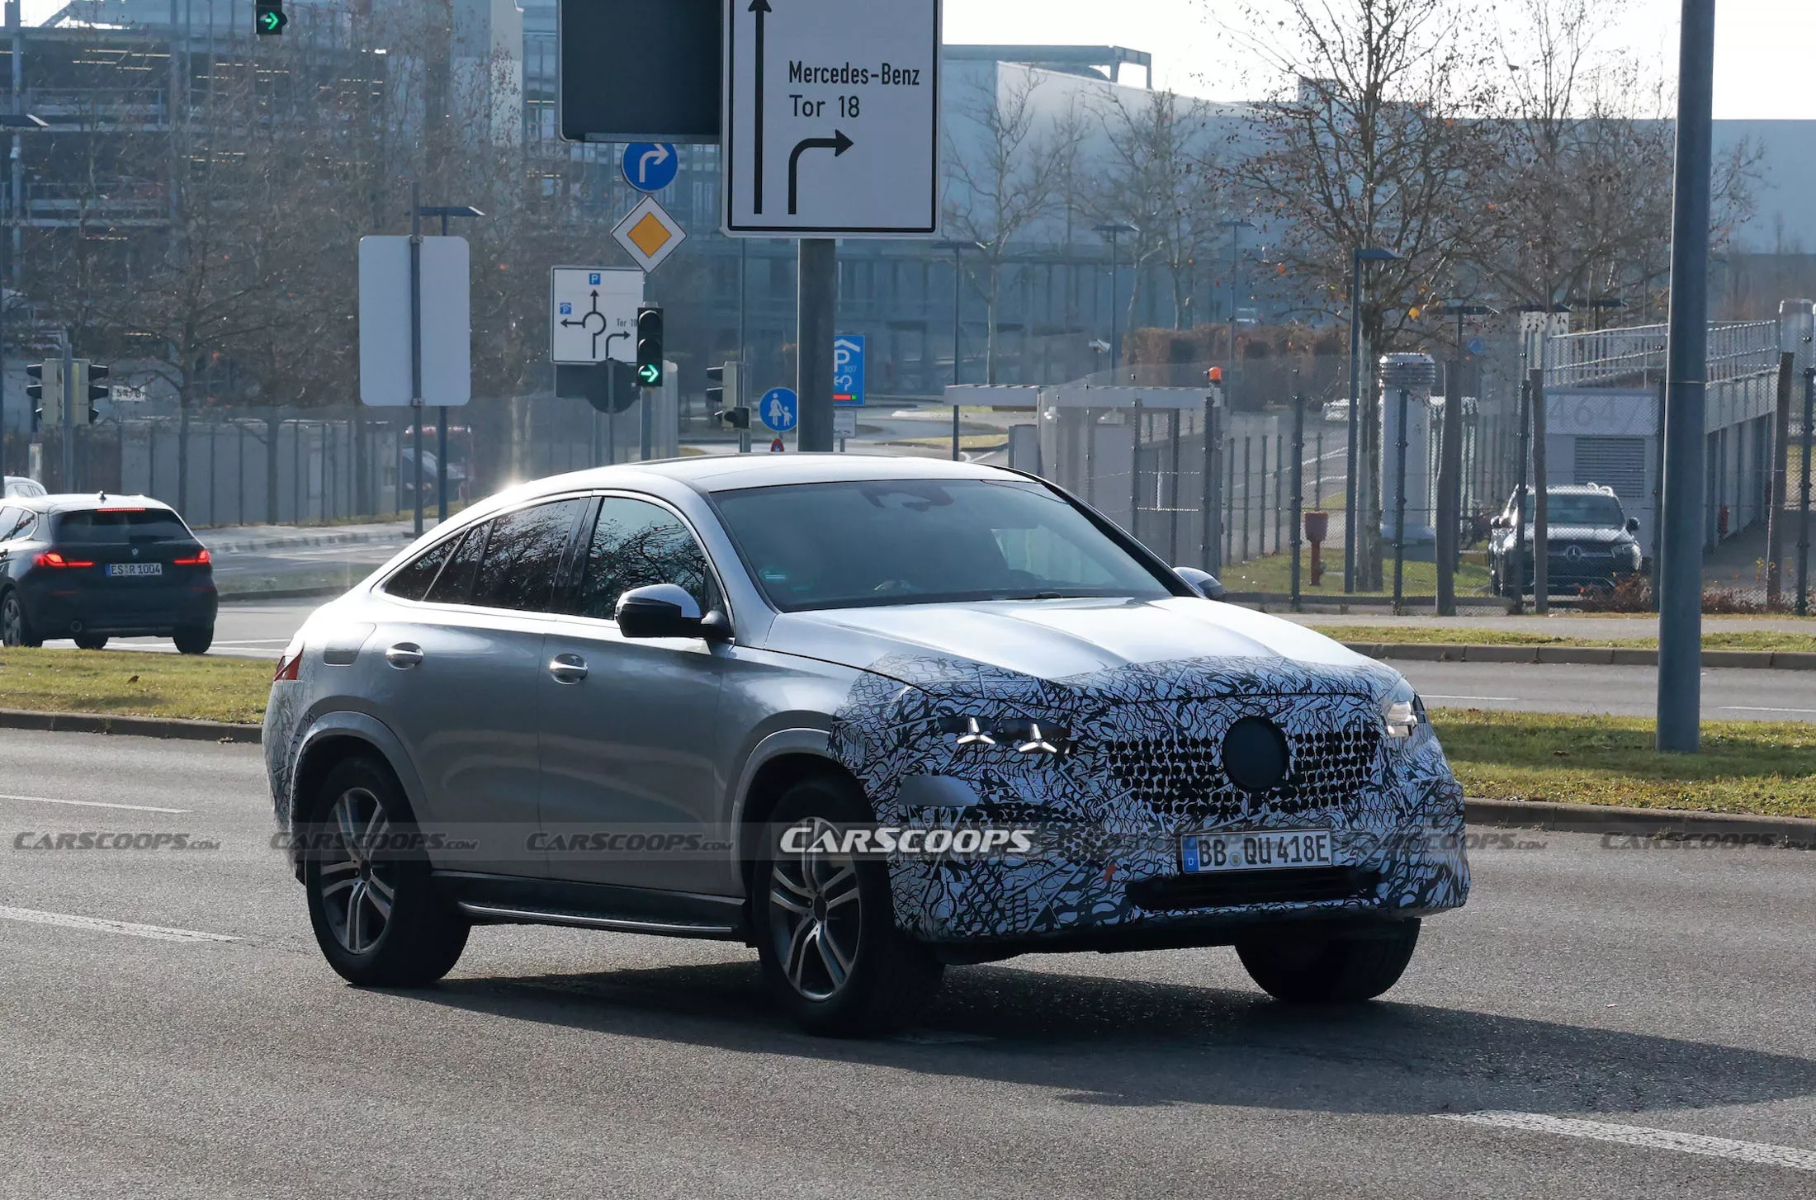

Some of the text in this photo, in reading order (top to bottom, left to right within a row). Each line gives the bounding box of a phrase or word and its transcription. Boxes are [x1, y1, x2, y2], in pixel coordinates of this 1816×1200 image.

[788, 60, 920, 86] Mercedes-Benz
[788, 94, 860, 118] Tor 18
[591, 274, 599, 284] P
[616, 318, 627, 327] Tor
[834, 350, 851, 372] P
[111, 565, 124, 575] ES
[138, 564, 160, 574] 1004
[1199, 839, 1227, 867] BB
[1244, 837, 1272, 865] QU
[1277, 834, 1331, 864] 418E
